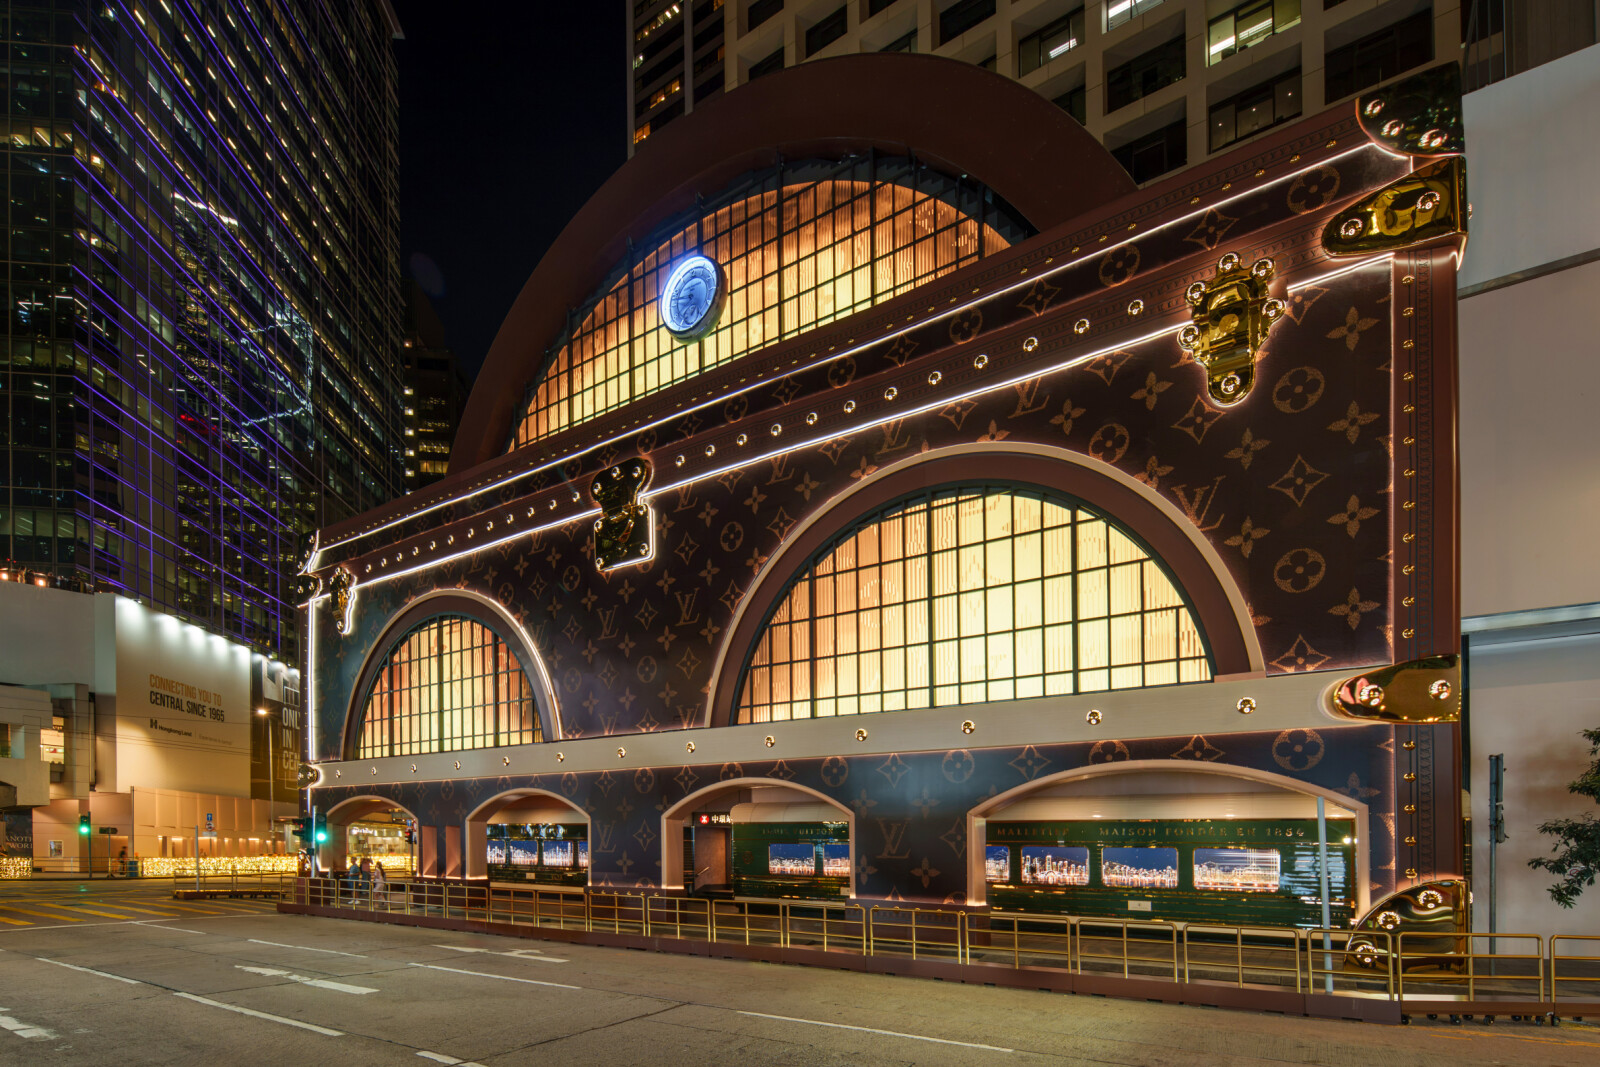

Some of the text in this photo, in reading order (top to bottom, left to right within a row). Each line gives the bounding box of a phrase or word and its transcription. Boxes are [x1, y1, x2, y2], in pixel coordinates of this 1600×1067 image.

[149, 673, 222, 706] CONNECTING YOU TO
[150, 690, 225, 722] CENTRAL SINCE 1965
[282, 707, 300, 730] ONL
[282, 728, 293, 749] IN
[1100, 826, 1156, 837] MAISON
